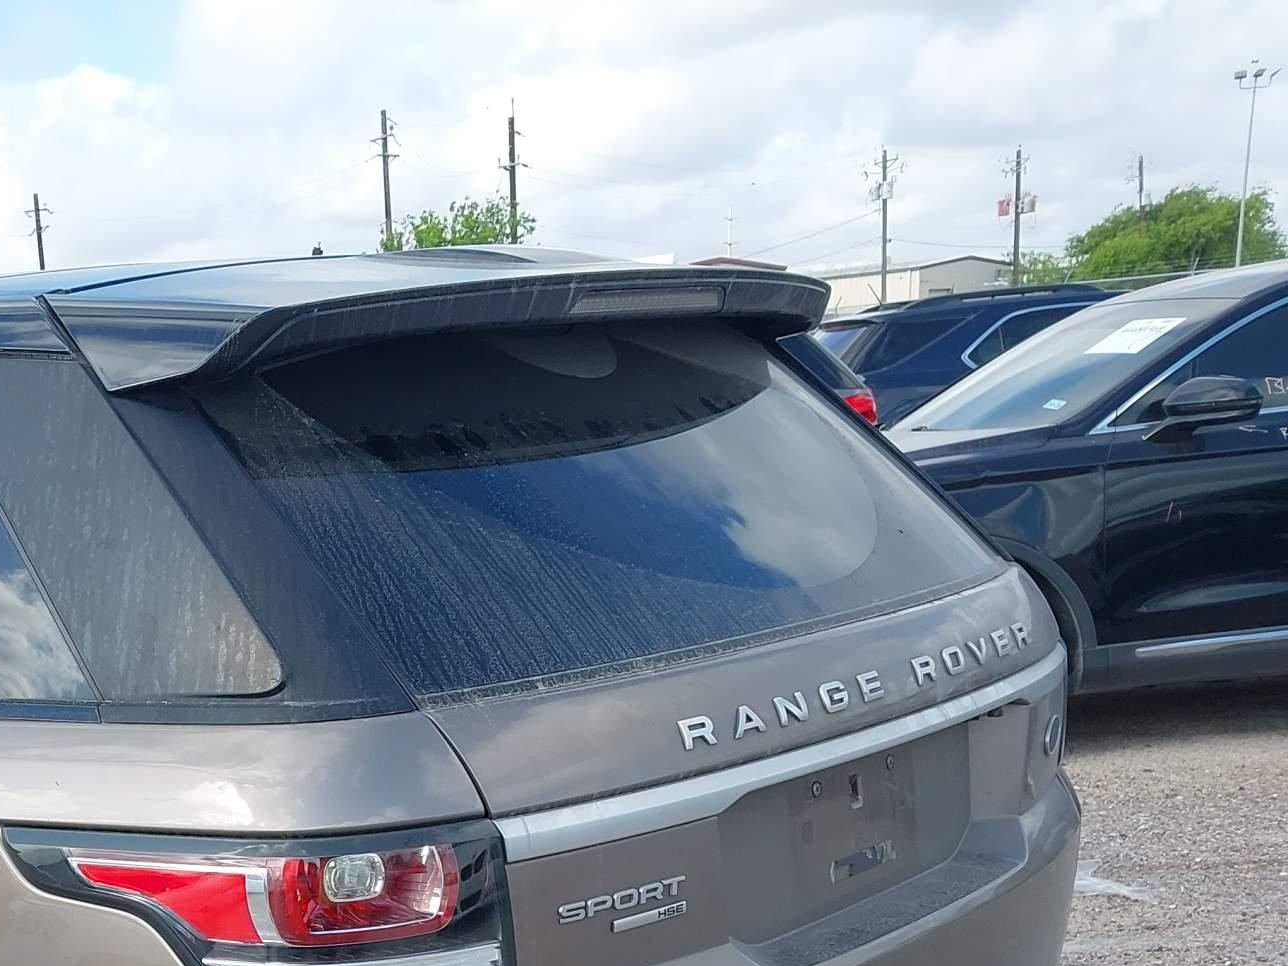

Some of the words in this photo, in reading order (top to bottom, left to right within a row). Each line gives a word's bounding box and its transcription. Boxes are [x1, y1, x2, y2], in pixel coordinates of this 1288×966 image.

[677, 669, 886, 751] RANGE
[911, 621, 1032, 687] ROVER
[558, 874, 687, 924] SPORT
[658, 903, 684, 918] HSE
